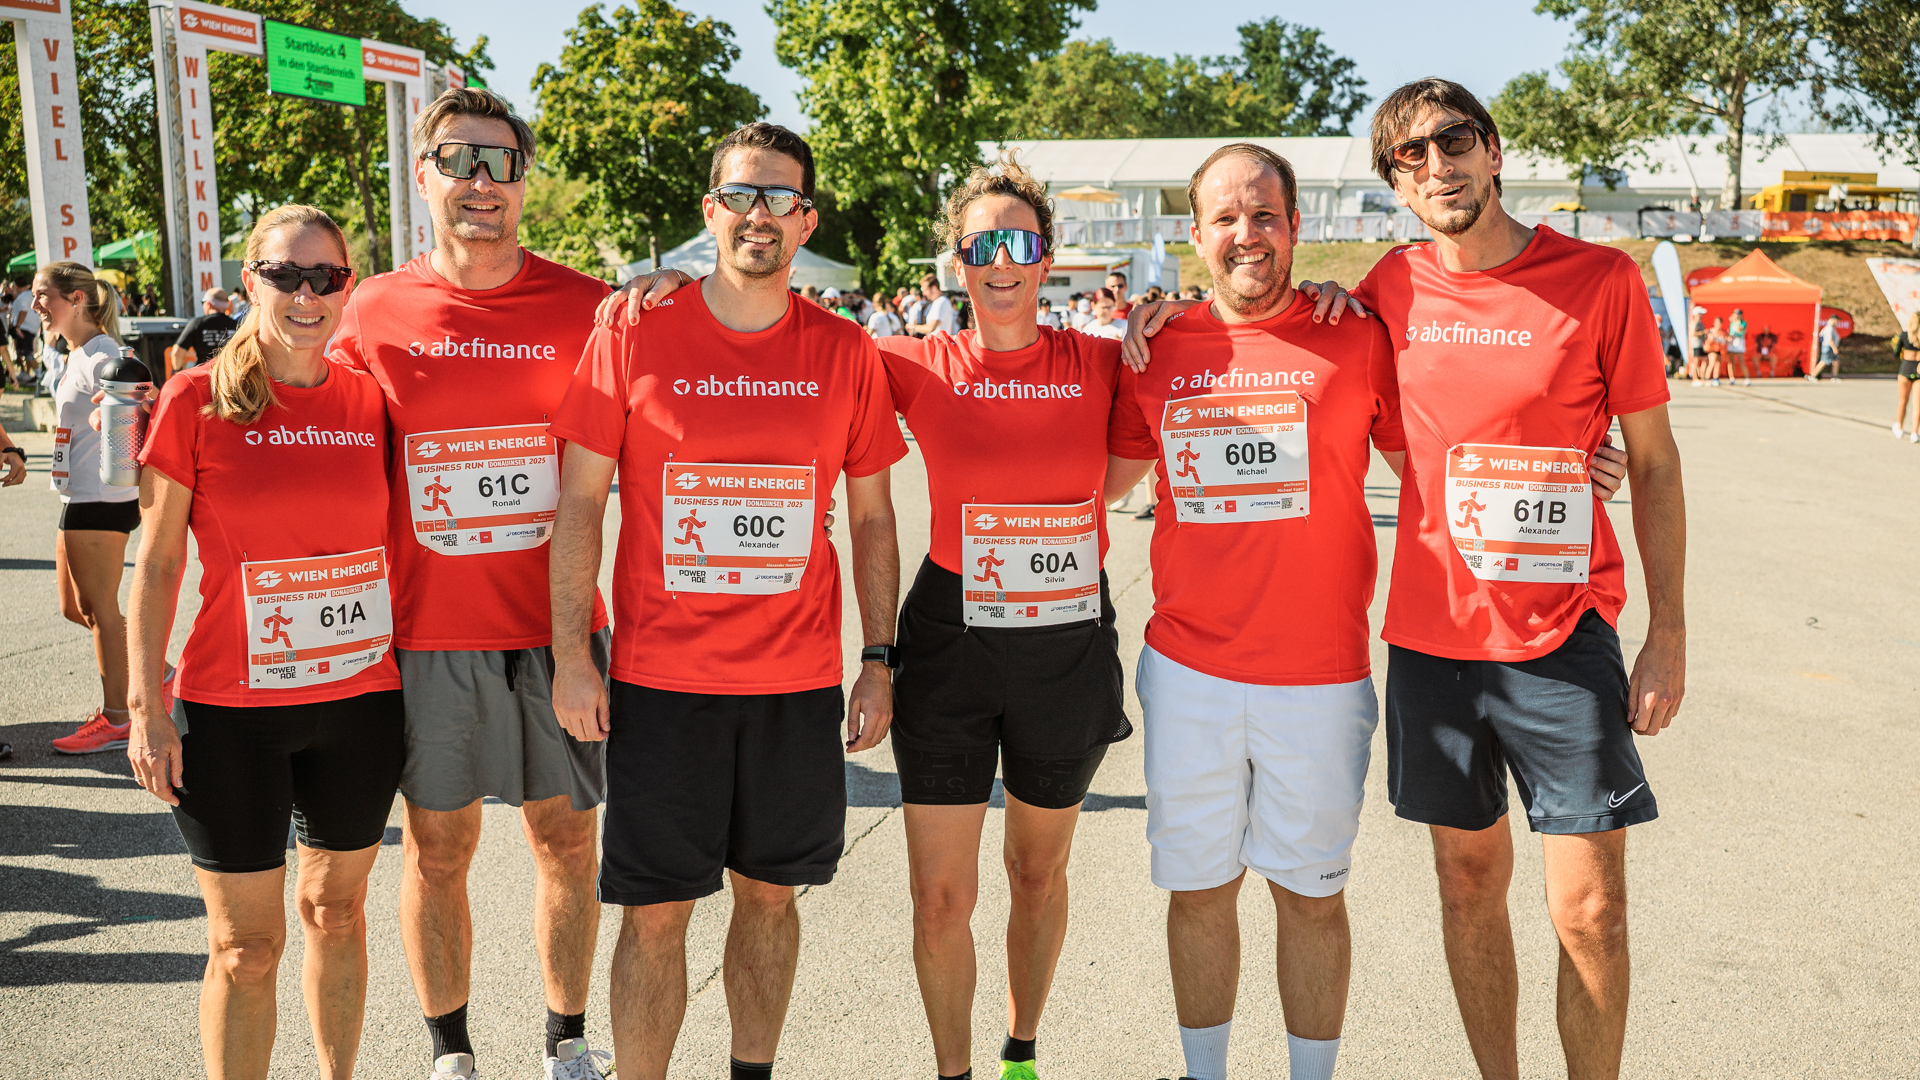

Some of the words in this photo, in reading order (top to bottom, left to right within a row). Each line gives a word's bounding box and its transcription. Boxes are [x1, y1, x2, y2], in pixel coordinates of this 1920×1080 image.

[200, 18, 221, 31] WIEN
[222, 22, 254, 38] ENERGIE
[284, 36, 336, 58] Startblock
[338, 42, 347, 60] 4
[288, 57, 305, 71] den
[305, 61, 356, 79] Startbereich
[43, 38, 68, 161] VIEL
[1420, 320, 1532, 347] abcfinance
[430, 335, 556, 361] abcfinance
[696, 375, 819, 397] abcfinance
[1189, 367, 1315, 389] abcfinance
[973, 377, 1082, 399] abcfinance
[1197, 406, 1234, 419] WIEN
[1238, 403, 1297, 417] ENERGIE
[268, 425, 376, 447] abcfinance
[1171, 429, 1210, 439] BUSINESS
[1213, 428, 1232, 436] RUN
[1236, 426, 1273, 435] DONAUINSEL
[446, 440, 485, 453] WIEN
[488, 436, 547, 450] ENERGIE
[1225, 441, 1277, 465] 60B
[417, 463, 462, 473] BUSINESS
[465, 462, 484, 470] RUN
[488, 459, 526, 468] DONAUINSEL
[529, 457, 546, 465] 2025
[1237, 467, 1267, 476] Michael
[1489, 458, 1529, 472] WIEN
[478, 473, 530, 498] 61C
[706, 476, 745, 488] WIEN
[748, 477, 806, 490] ENERGIE
[1456, 480, 1501, 489] BUSINESS
[1503, 482, 1525, 490] RUN
[1528, 483, 1567, 493] DONAUINSEL
[1569, 485, 1585, 493] 2025
[492, 499, 521, 507] Ronald
[674, 498, 719, 506] BUSINESS
[745, 500, 784, 508] DONAUINSEL
[1514, 499, 1567, 524] 61B
[733, 515, 785, 538] 60C
[1004, 517, 1041, 528] WIEN
[1044, 512, 1093, 528] ENERGIE
[430, 533, 457, 541] POWER
[1518, 526, 1560, 535] Alexander
[738, 541, 780, 549] Alexander
[1042, 537, 1077, 546] DONAUINSEL
[1079, 534, 1092, 542] 2025
[1030, 551, 1079, 574] 60A
[1462, 553, 1483, 562] OWER
[288, 569, 328, 583] WIEN
[332, 560, 379, 579] ENERGIE
[679, 569, 707, 577] POWER
[691, 576, 707, 584] ADE
[1044, 576, 1065, 584] Silvia
[256, 593, 305, 605] BUSINESS
[307, 591, 327, 600] RUN
[330, 585, 363, 598] DONAUINSEL
[365, 582, 378, 591] 2025
[320, 601, 366, 628] 61A
[336, 628, 354, 636] Ilona
[266, 665, 296, 675] POWER
[280, 672, 297, 680] ADE
[307, 666, 316, 674] AK
[1320, 867, 1349, 881] HEAD
